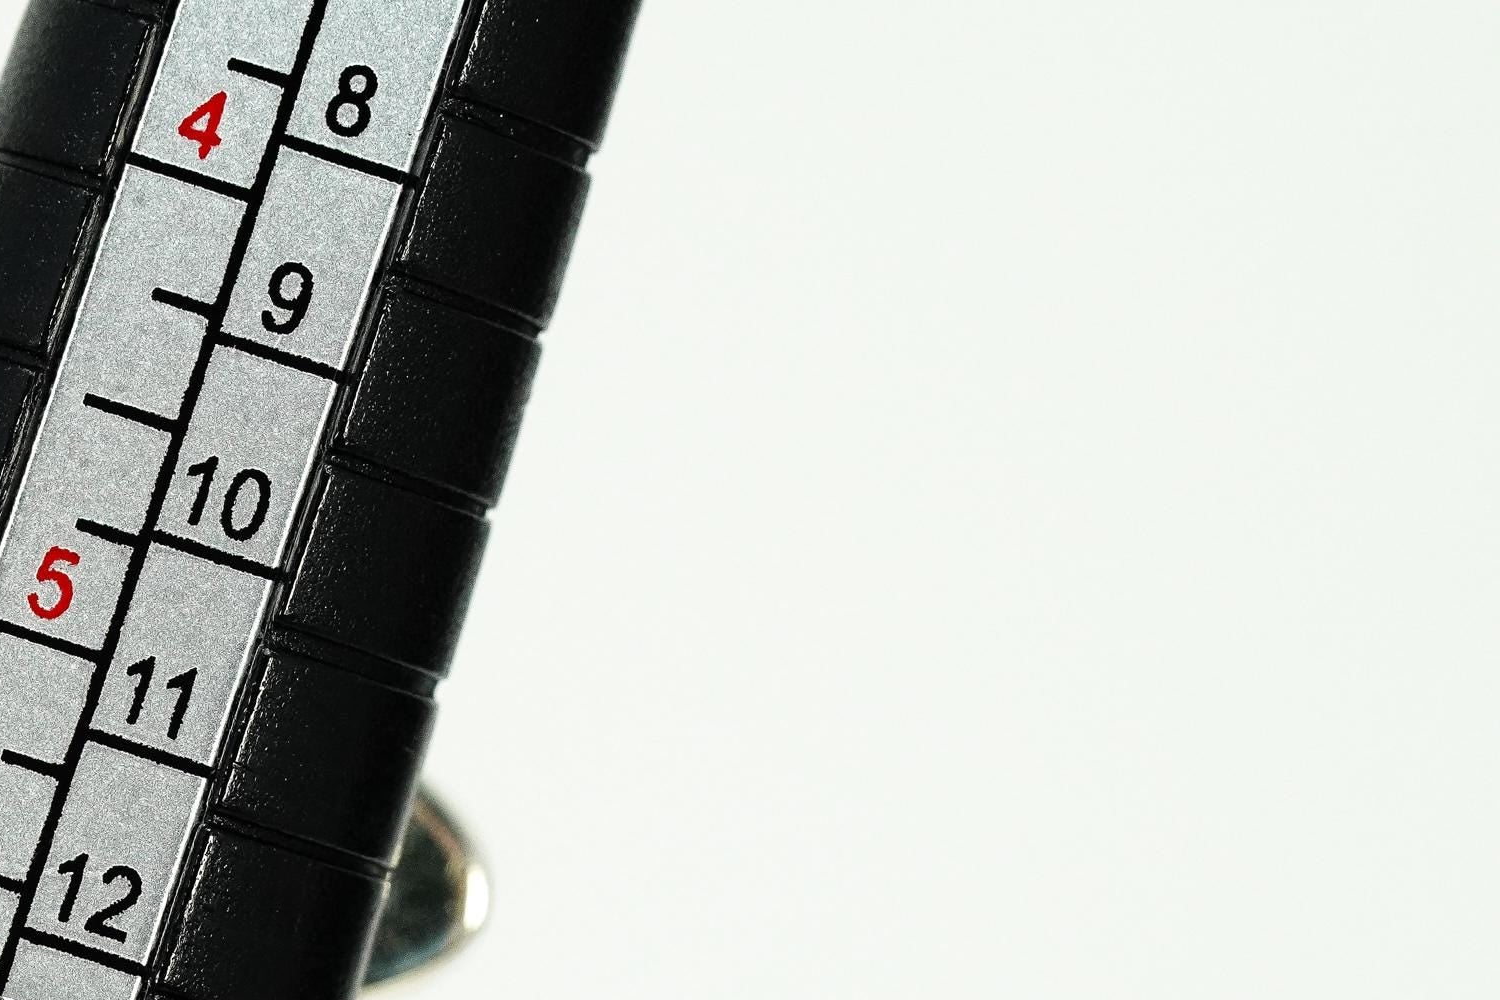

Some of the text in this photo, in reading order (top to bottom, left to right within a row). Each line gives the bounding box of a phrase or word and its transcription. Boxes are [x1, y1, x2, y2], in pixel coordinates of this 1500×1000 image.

[178, 91, 227, 159] 4
[327, 65, 378, 138] 8
[262, 261, 314, 335] 9
[186, 456, 272, 542] 10
[28, 546, 81, 619] 5
[125, 655, 198, 740] 11
[56, 854, 143, 943] 12
